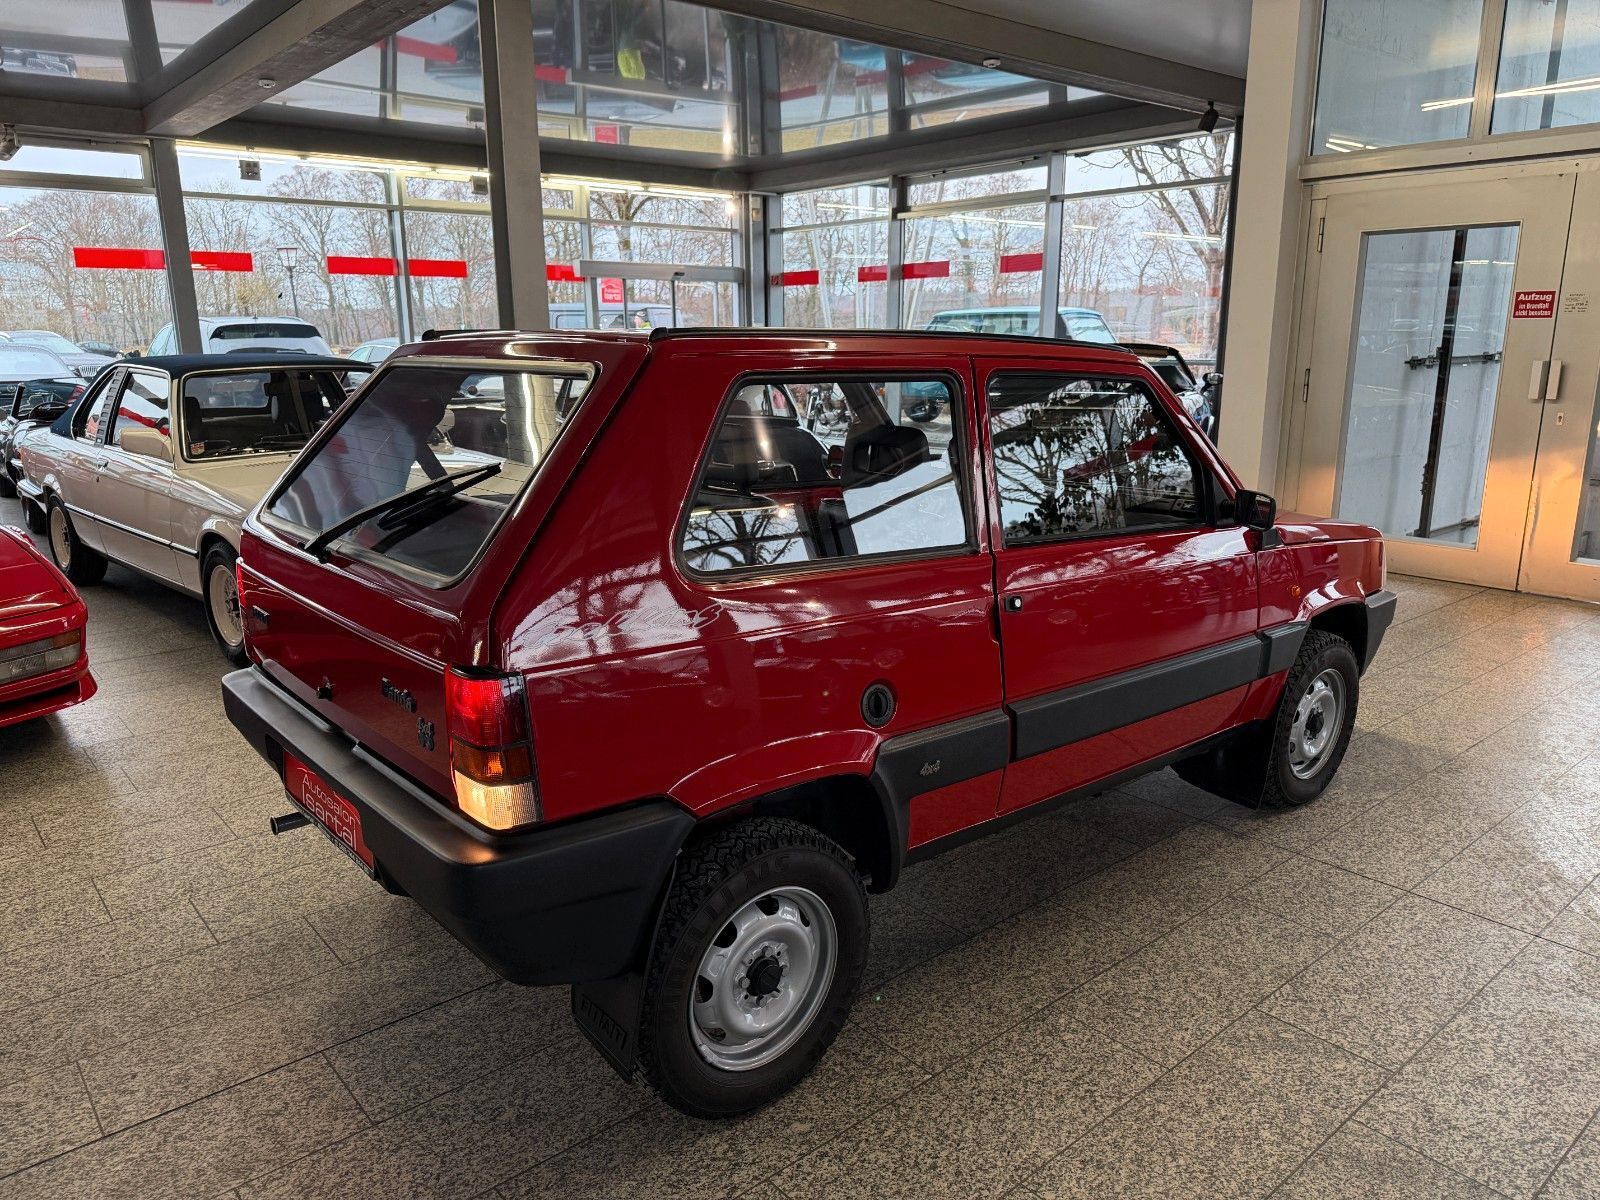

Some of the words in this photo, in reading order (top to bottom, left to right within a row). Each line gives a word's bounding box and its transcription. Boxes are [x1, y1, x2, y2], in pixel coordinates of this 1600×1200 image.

[1518, 293, 1552, 302] Aufzug
[302, 773, 356, 826] Autosalon
[580, 993, 628, 1050] FIAT
